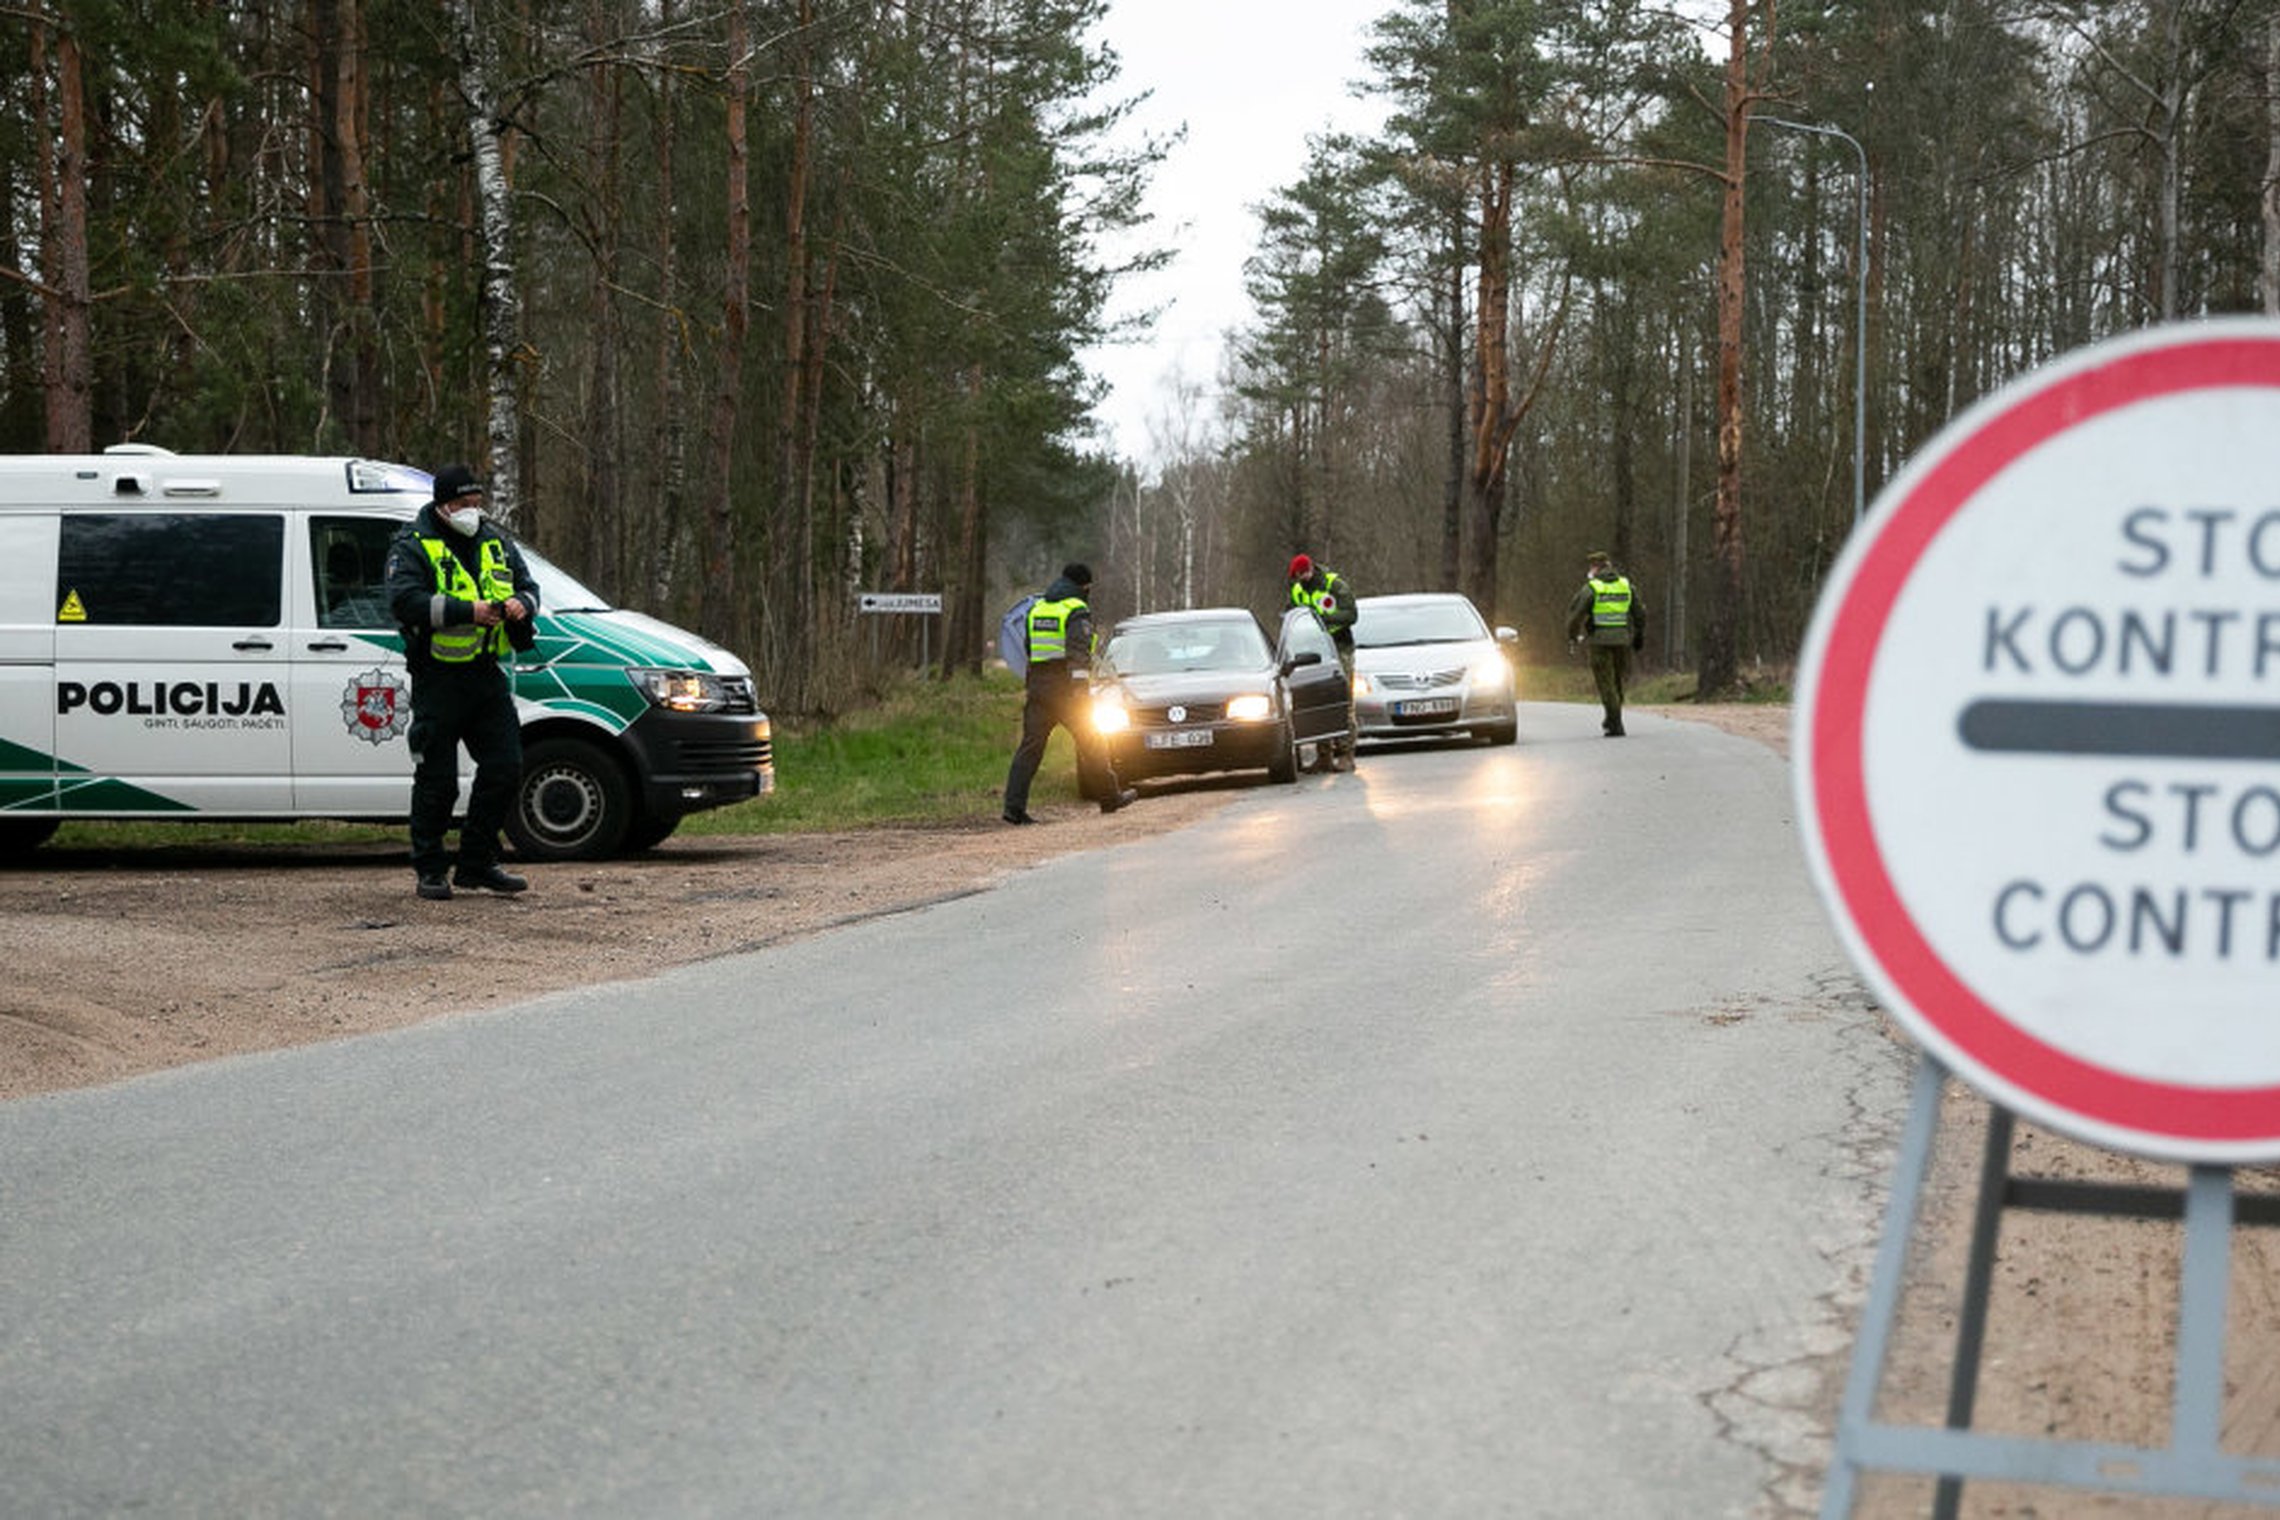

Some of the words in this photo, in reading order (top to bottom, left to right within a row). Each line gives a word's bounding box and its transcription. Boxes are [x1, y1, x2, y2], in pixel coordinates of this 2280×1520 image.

[57, 681, 285, 716] POLICIJA
[2099, 779, 2280, 858] STO
[1993, 879, 2280, 961] CONT
